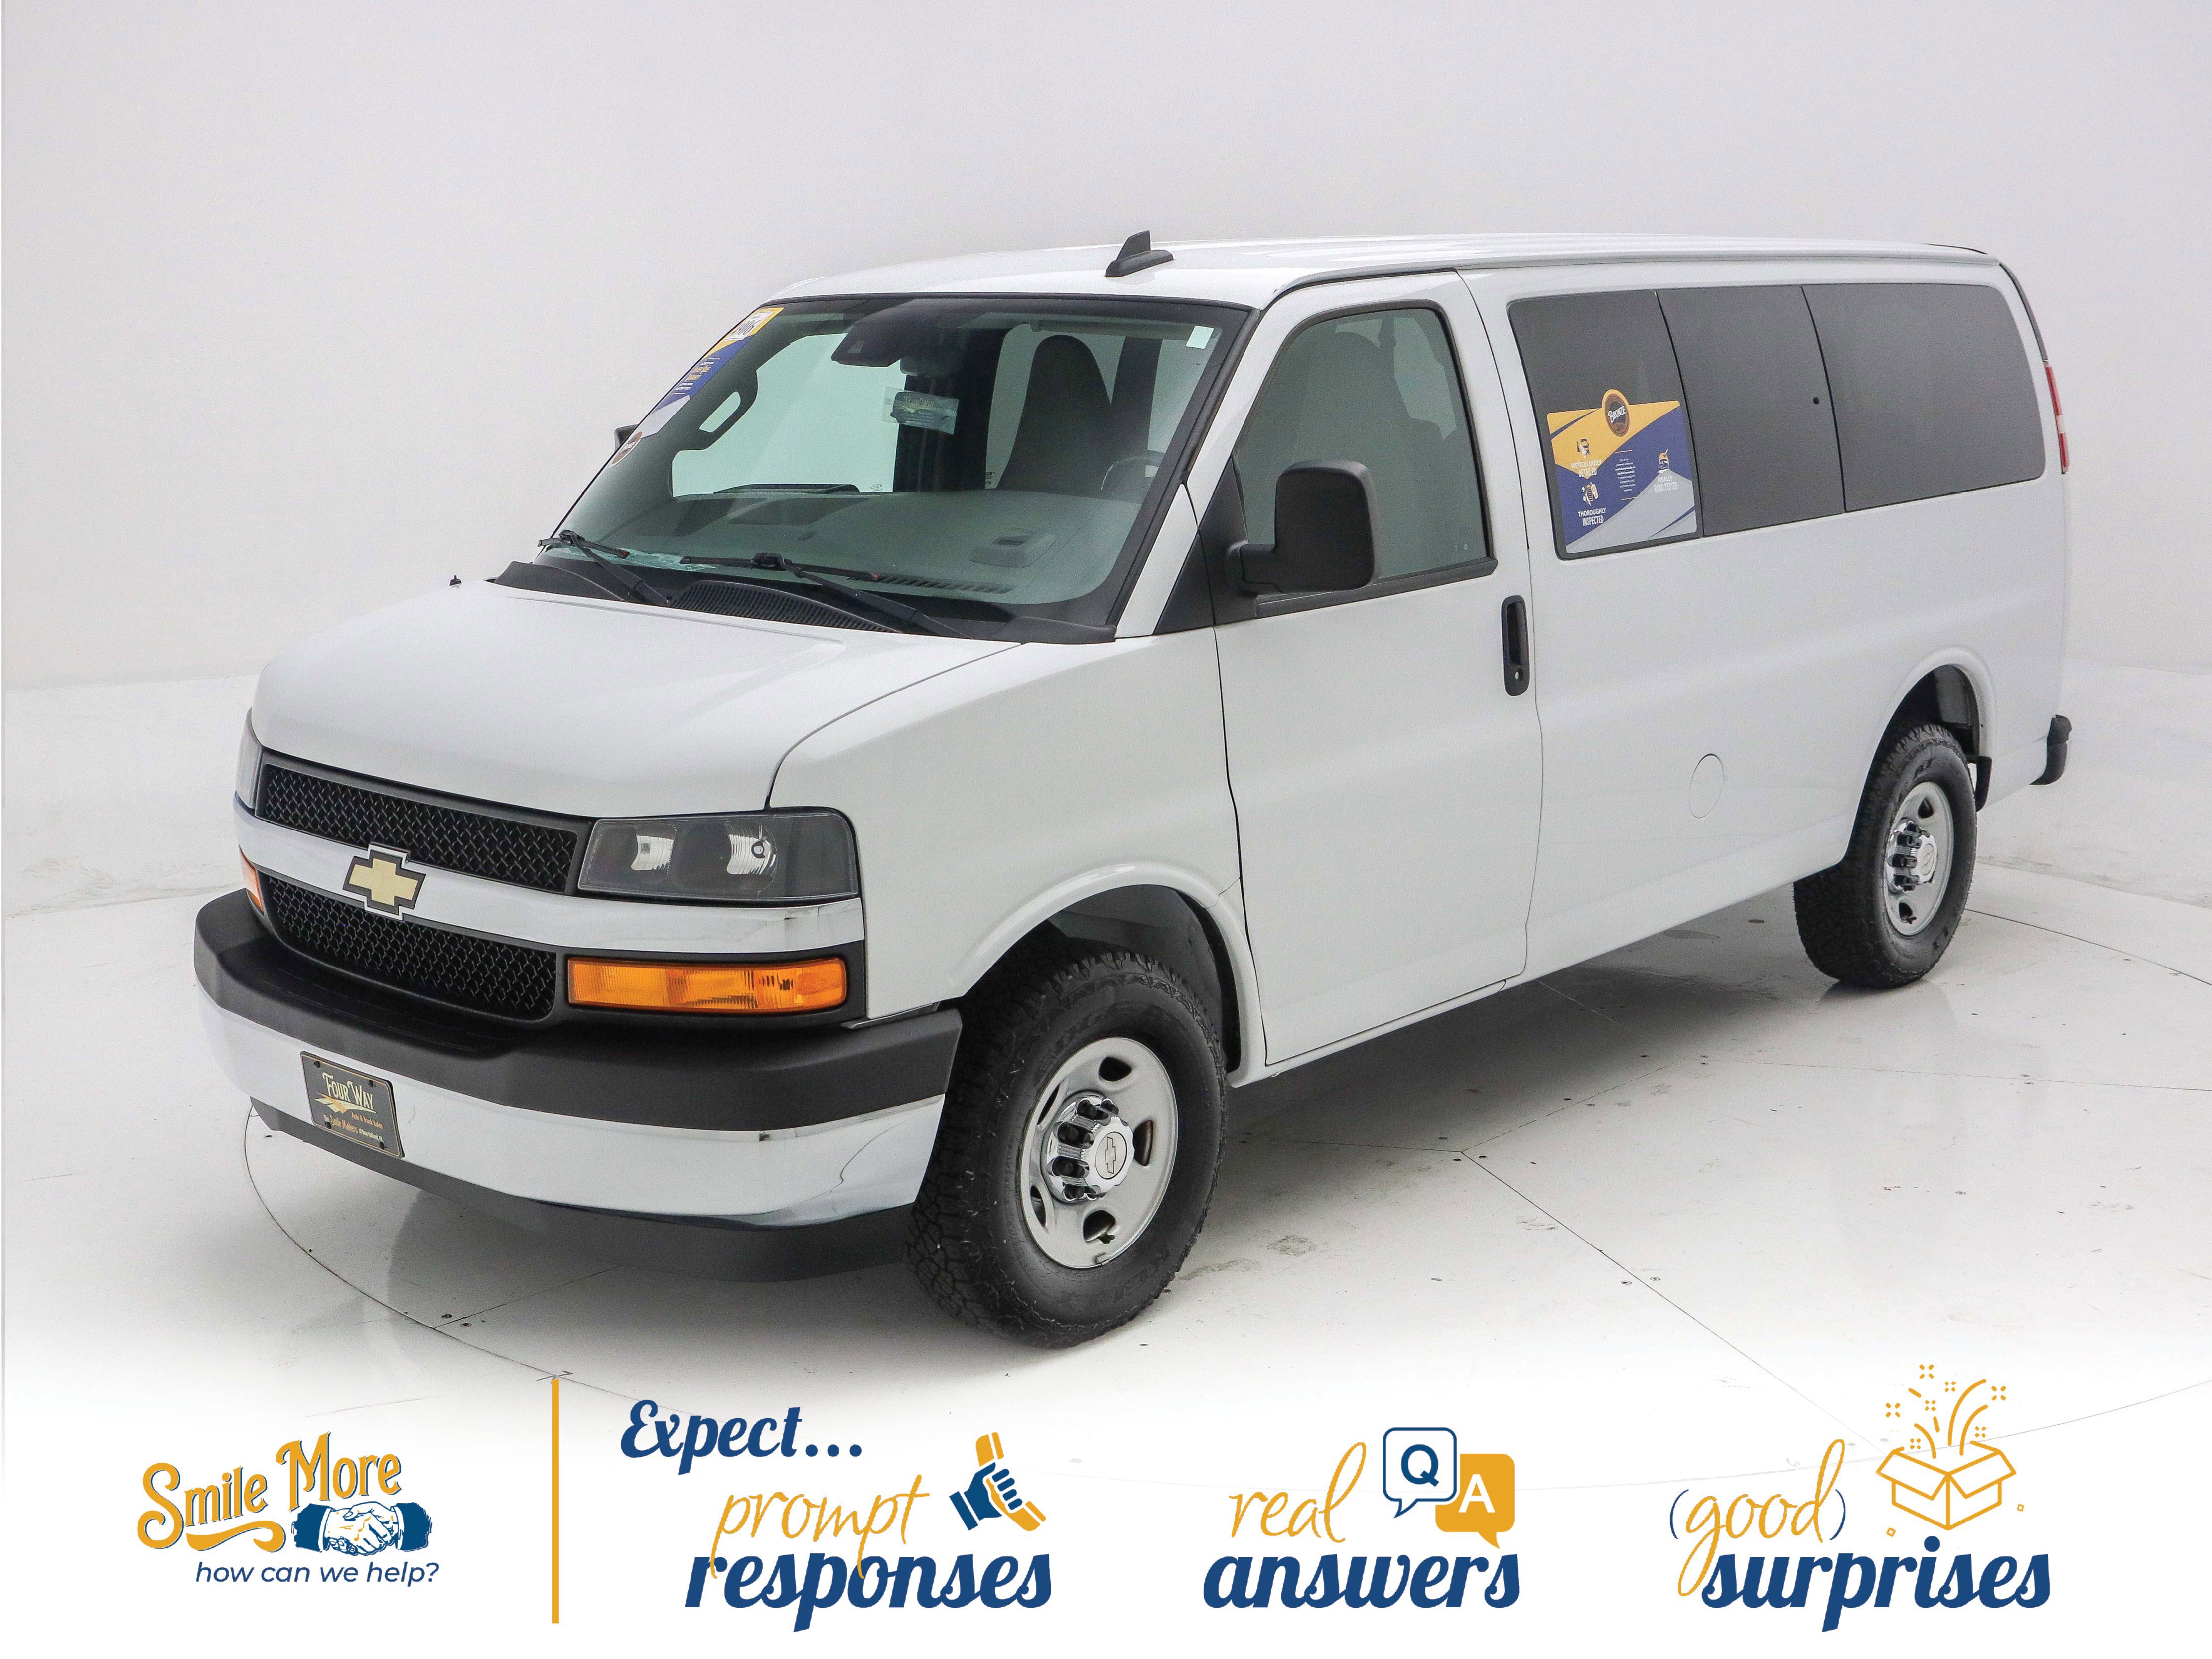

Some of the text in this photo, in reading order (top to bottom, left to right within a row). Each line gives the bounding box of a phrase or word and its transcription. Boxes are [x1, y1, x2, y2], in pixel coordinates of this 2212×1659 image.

[1608, 405, 1626, 423] BRONZE
[1571, 460, 1602, 469] METICULOUSLY
[1578, 467, 1597, 478] DETAILED
[1664, 482, 1678, 491] TESTED
[1578, 507, 1606, 517] THOROUGHLY
[1582, 515, 1604, 527] INSPECTED
[322, 1072, 374, 1110] FOUR WAY
